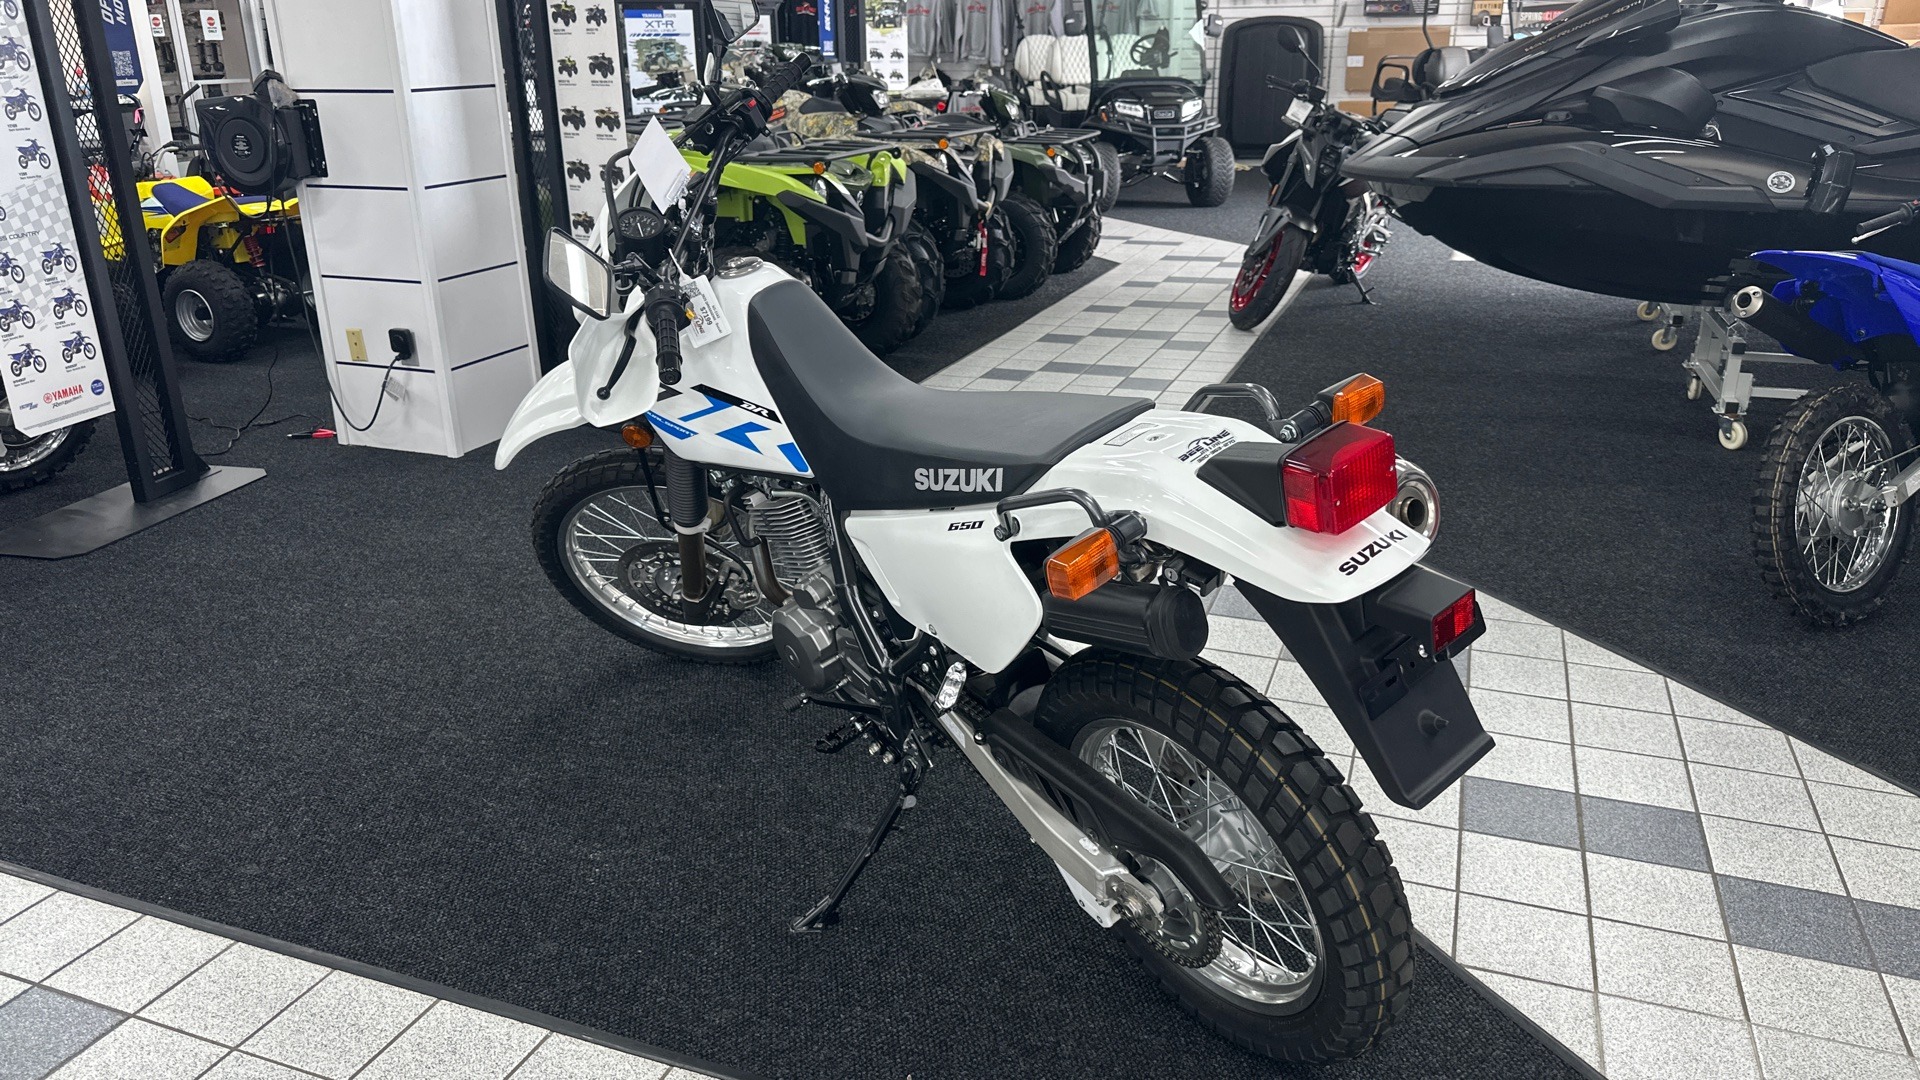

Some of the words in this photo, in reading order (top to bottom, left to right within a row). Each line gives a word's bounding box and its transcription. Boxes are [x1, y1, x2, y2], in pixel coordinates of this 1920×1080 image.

[645, 20, 675, 28] XT-R
[9, 231, 40, 240] COUNTRY
[700, 306, 713, 326] $7199
[52, 384, 84, 401] YAMAHA
[740, 400, 769, 417] DR
[1178, 444, 1204, 462] BEE
[1203, 429, 1231, 446] LINE
[914, 467, 1004, 493] SUZUKI
[947, 520, 985, 531] 650
[1338, 529, 1408, 576] SUZUKI
